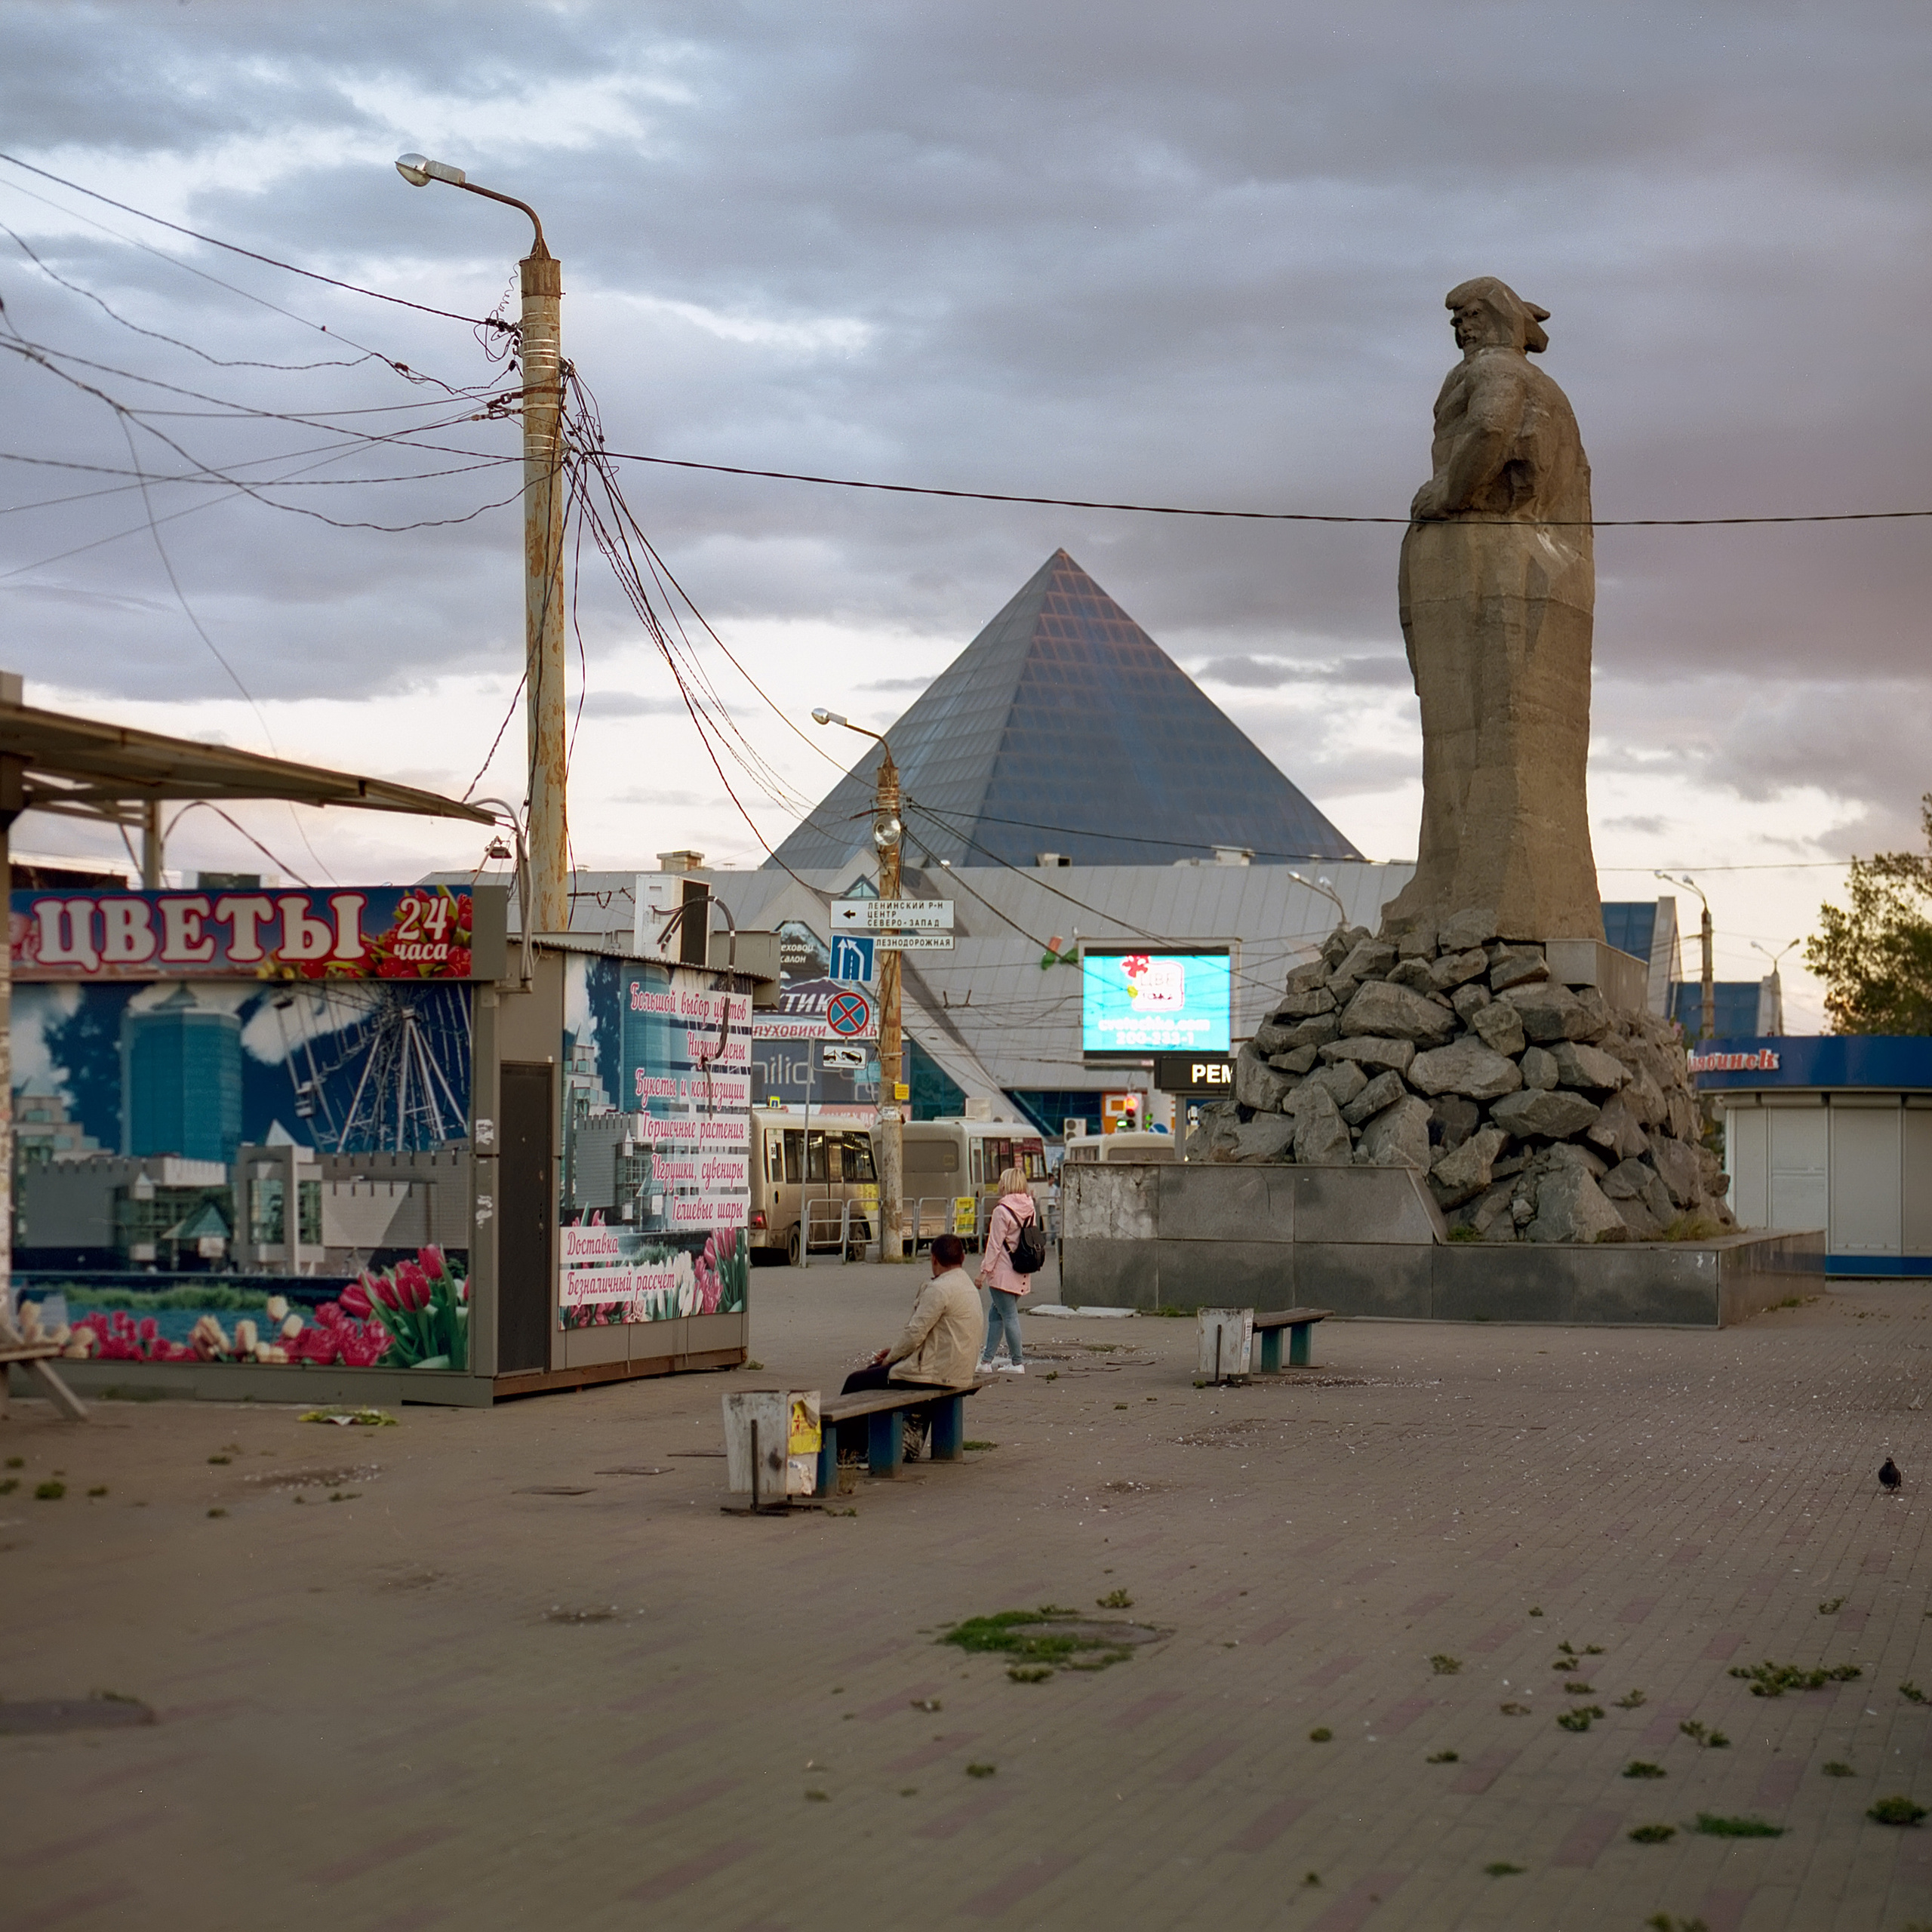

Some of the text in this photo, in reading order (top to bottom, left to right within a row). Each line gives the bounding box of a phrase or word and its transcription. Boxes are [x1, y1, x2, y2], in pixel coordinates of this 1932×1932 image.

[33, 893, 367, 973] ЦВЕТЫ
[397, 896, 449, 940] 24
[393, 943, 448, 961] часа
[780, 955, 807, 964] салон
[631, 983, 746, 1027] Большой выбор цвтов
[754, 1026, 826, 1037] ПУХОВИКИ
[635, 1069, 676, 1106] Букеты
[681, 1080, 687, 1096] и
[642, 1112, 744, 1149] Горшечные растения
[652, 1154, 743, 1191] Игрушки, сувениры
[672, 1196, 743, 1229] Гелиевые шары
[567, 1231, 618, 1256] Доставка
[568, 1269, 675, 1306] Безналичный рассчет
